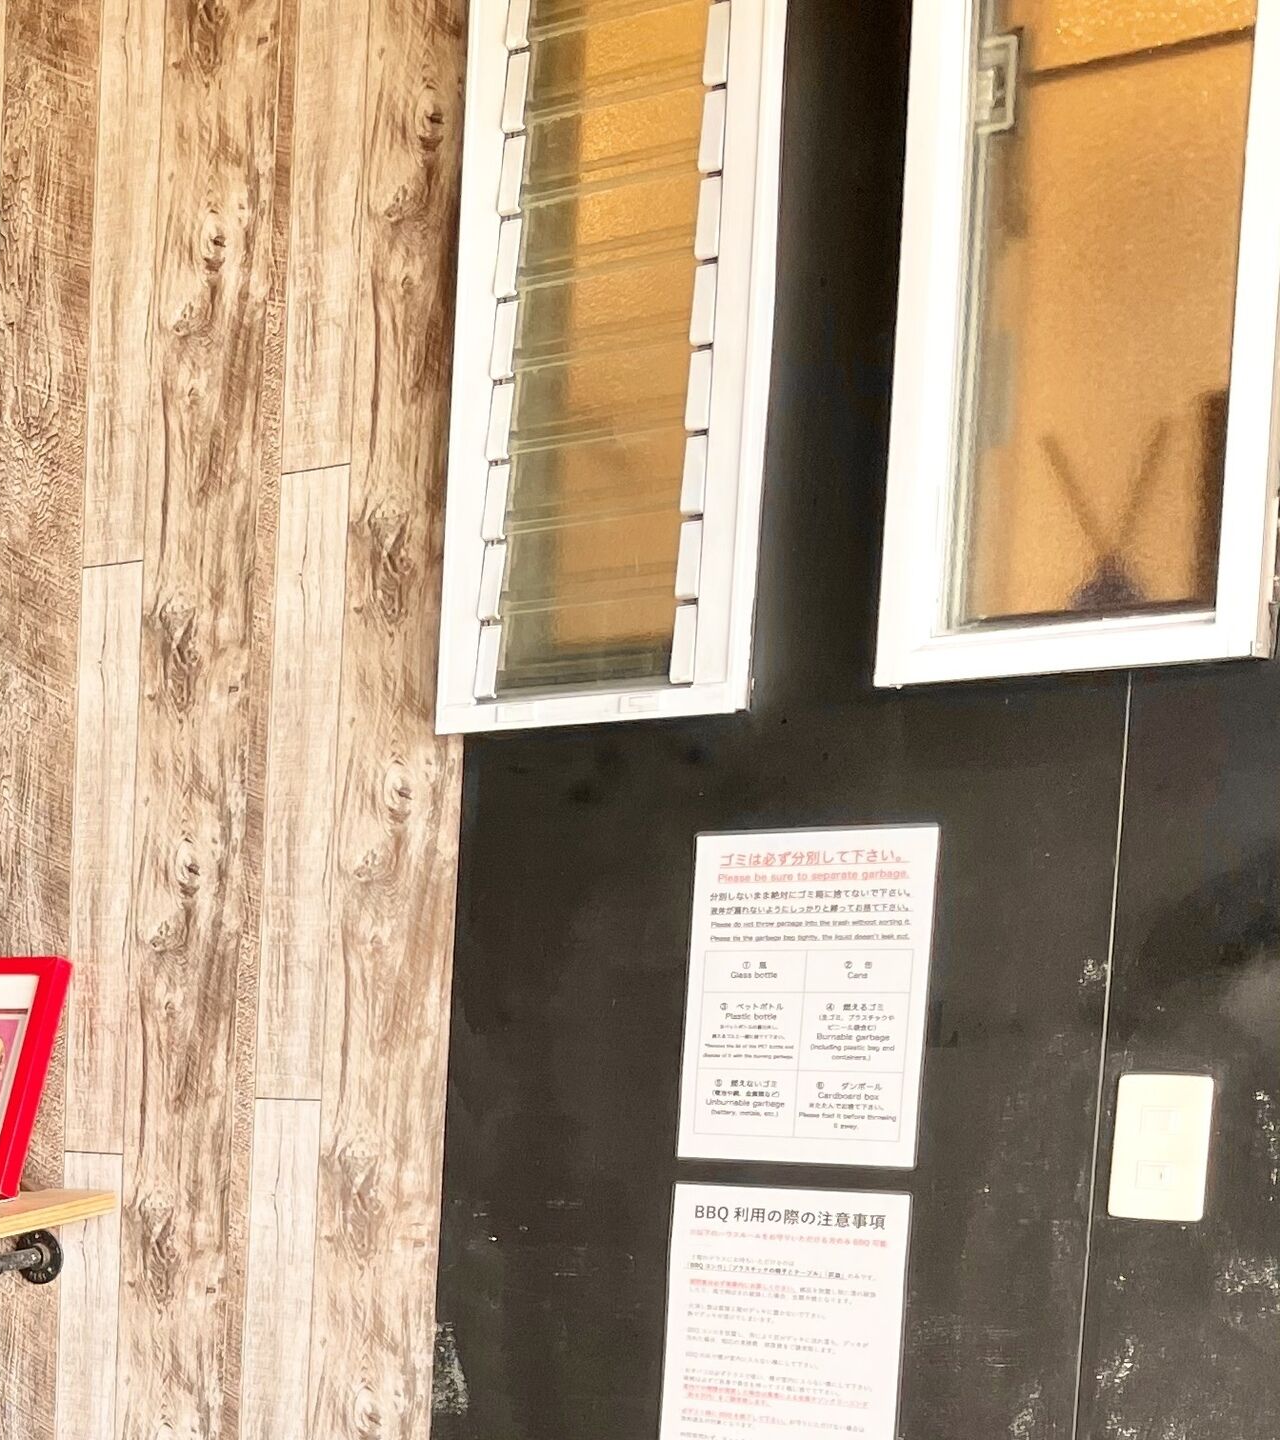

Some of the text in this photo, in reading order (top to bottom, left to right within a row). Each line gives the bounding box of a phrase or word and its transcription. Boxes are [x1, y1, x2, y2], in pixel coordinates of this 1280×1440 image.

[720, 849, 902, 866] ゴミは必ず分別して下さい。
[718, 873, 751, 883] Please
[754, 872, 767, 881] be
[771, 873, 793, 881] sure
[797, 872, 808, 880] to
[812, 870, 858, 880] separate
[731, 971, 752, 979] Glass
[847, 971, 868, 979] Cans
[816, 1033, 890, 1042] Burnable garbage
[818, 1092, 861, 1100] Cardboard
[706, 1098, 785, 1108] Unburnable garbage
[695, 1205, 886, 1230] BBQ 利用の際の注意事項
